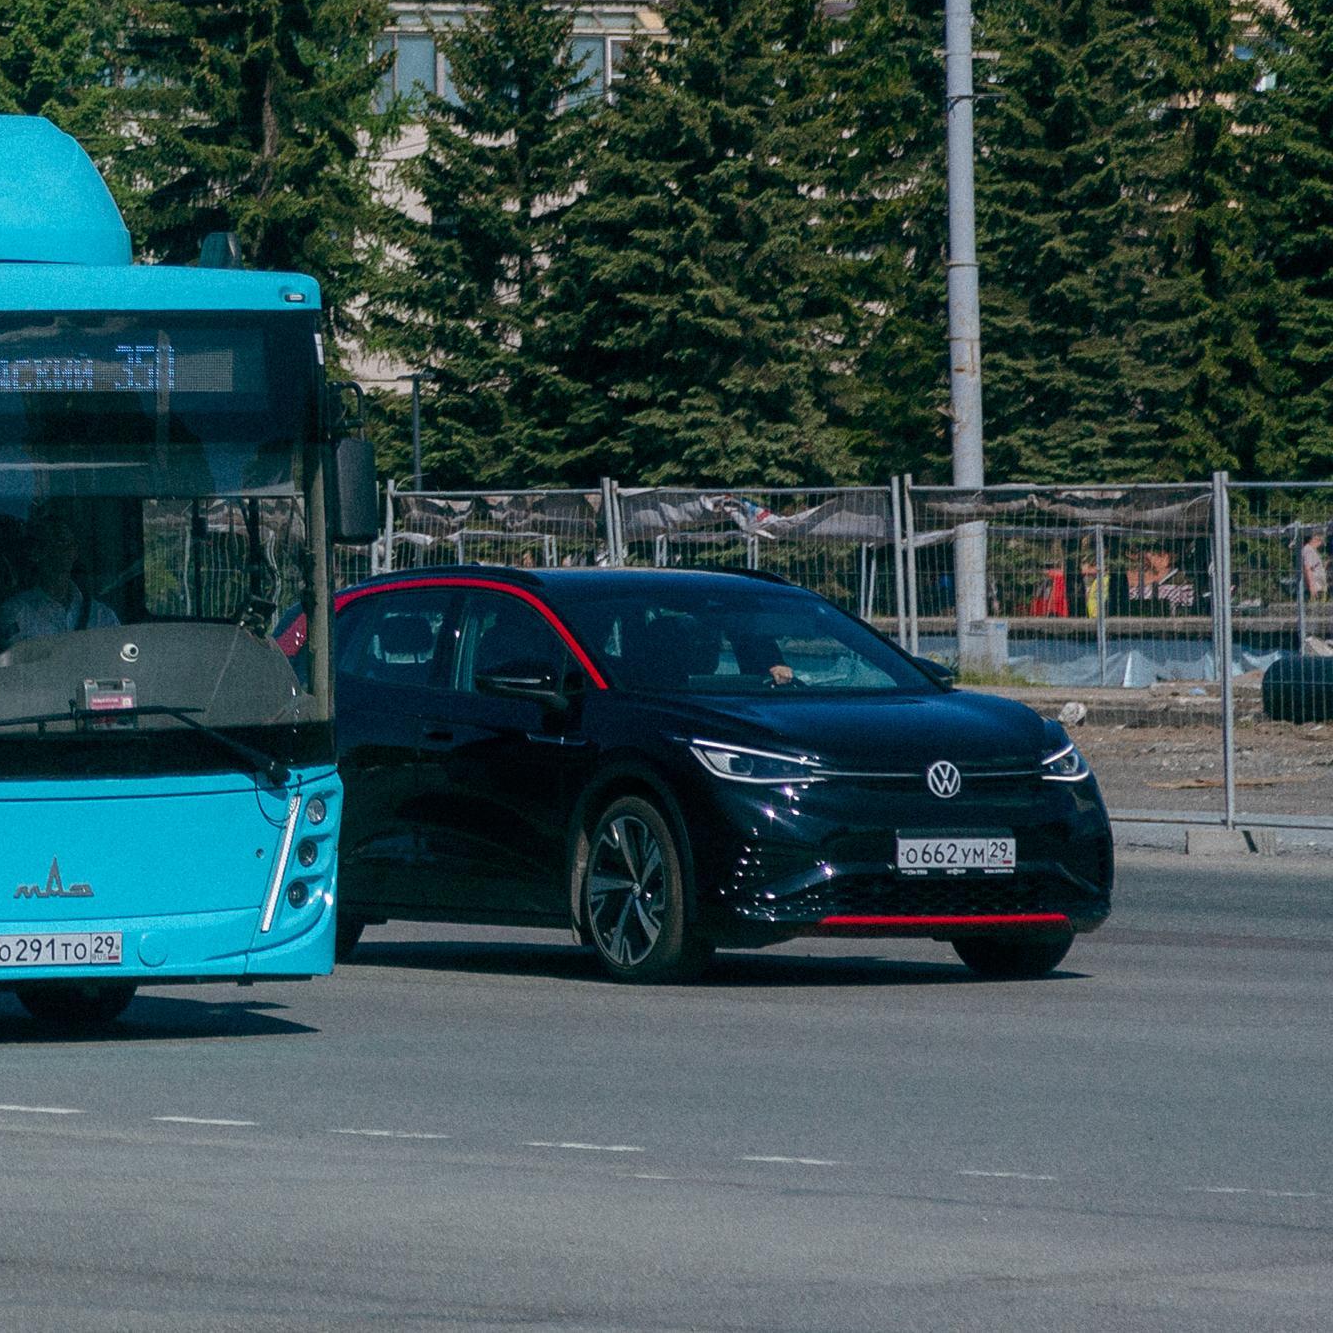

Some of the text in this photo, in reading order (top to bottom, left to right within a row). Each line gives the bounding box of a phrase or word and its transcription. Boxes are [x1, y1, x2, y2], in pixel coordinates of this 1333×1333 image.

[906, 841, 1008, 864] О662УМ 29
[94, 936, 115, 955] 29
